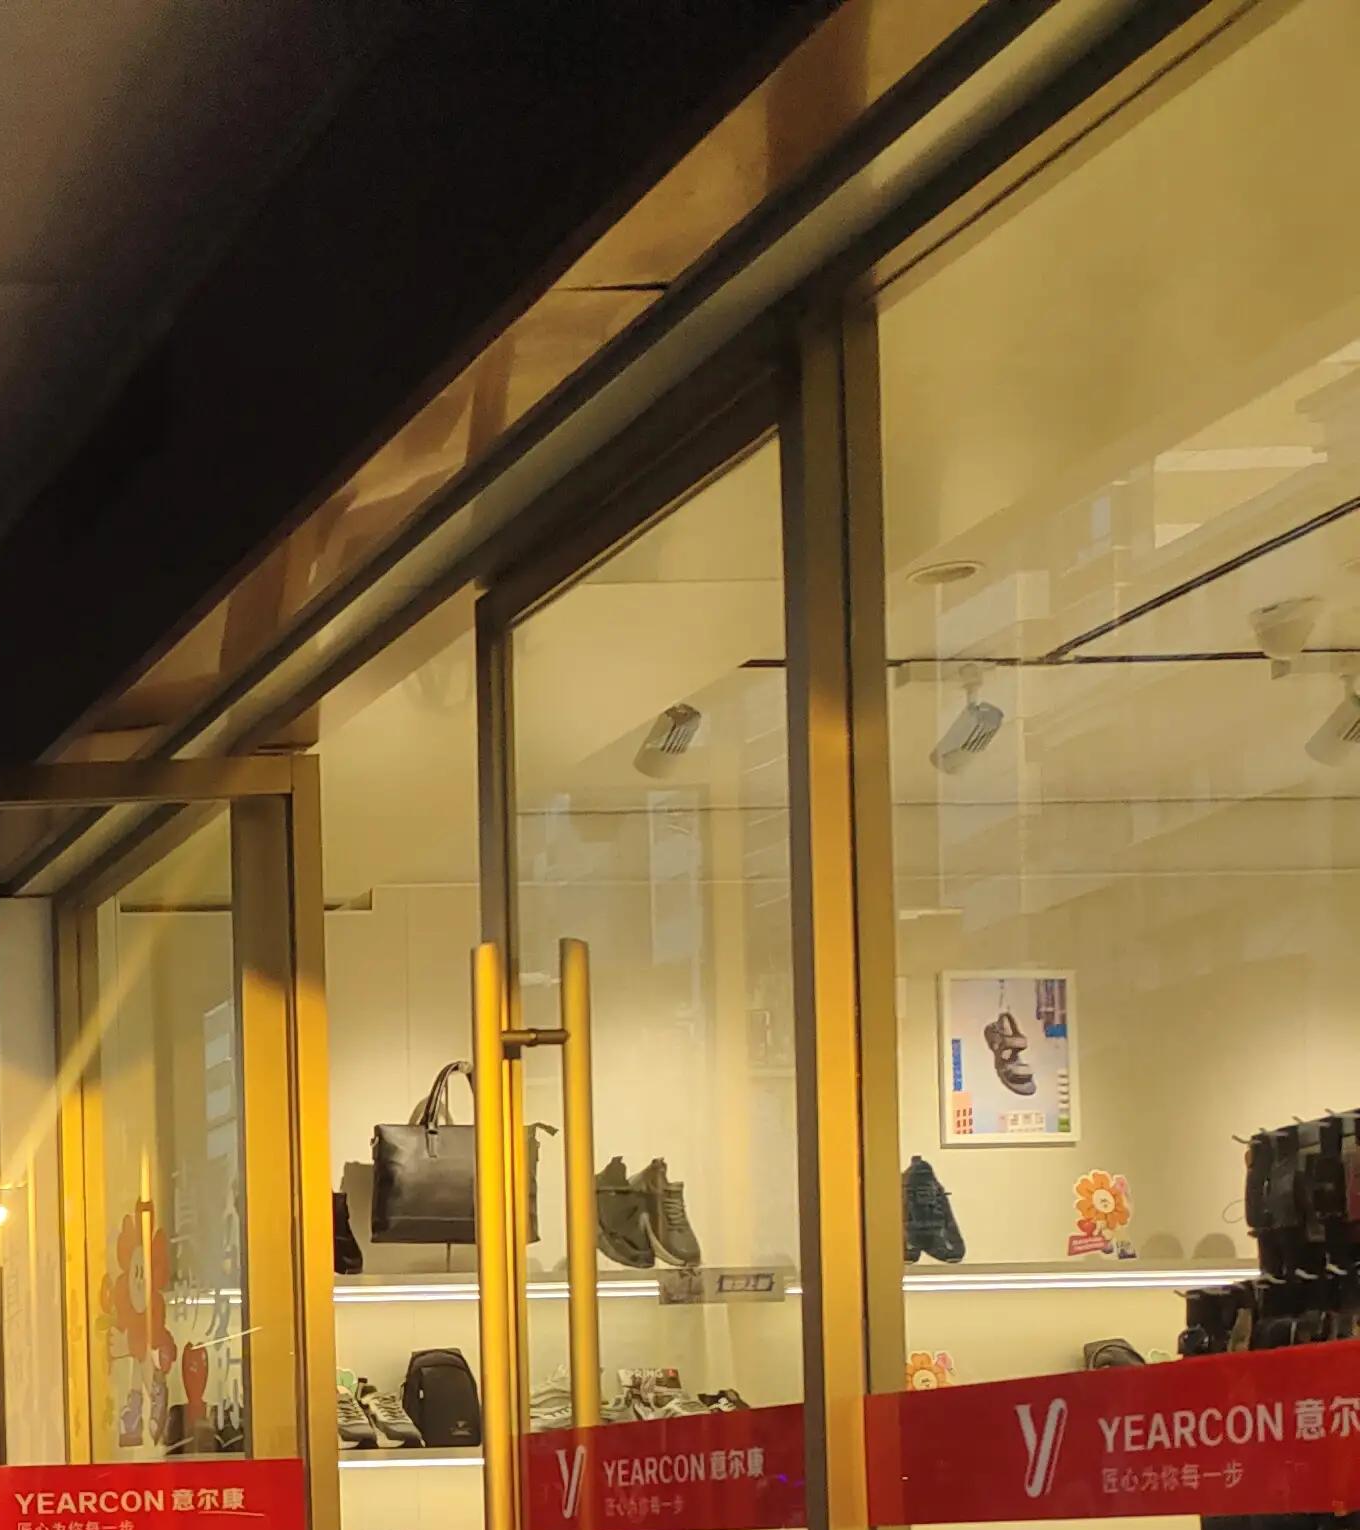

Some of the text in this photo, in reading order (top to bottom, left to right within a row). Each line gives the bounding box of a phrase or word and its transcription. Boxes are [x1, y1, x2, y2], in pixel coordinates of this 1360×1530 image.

[1097, 1401, 1283, 1454] YEARCON
[602, 1452, 706, 1488] YEARCON
[709, 1447, 765, 1481] 意尔康
[1101, 1459, 1244, 1495] 匠心为你每一步
[14, 1489, 165, 1516] YEARCON
[171, 1488, 247, 1512] 意尔康
